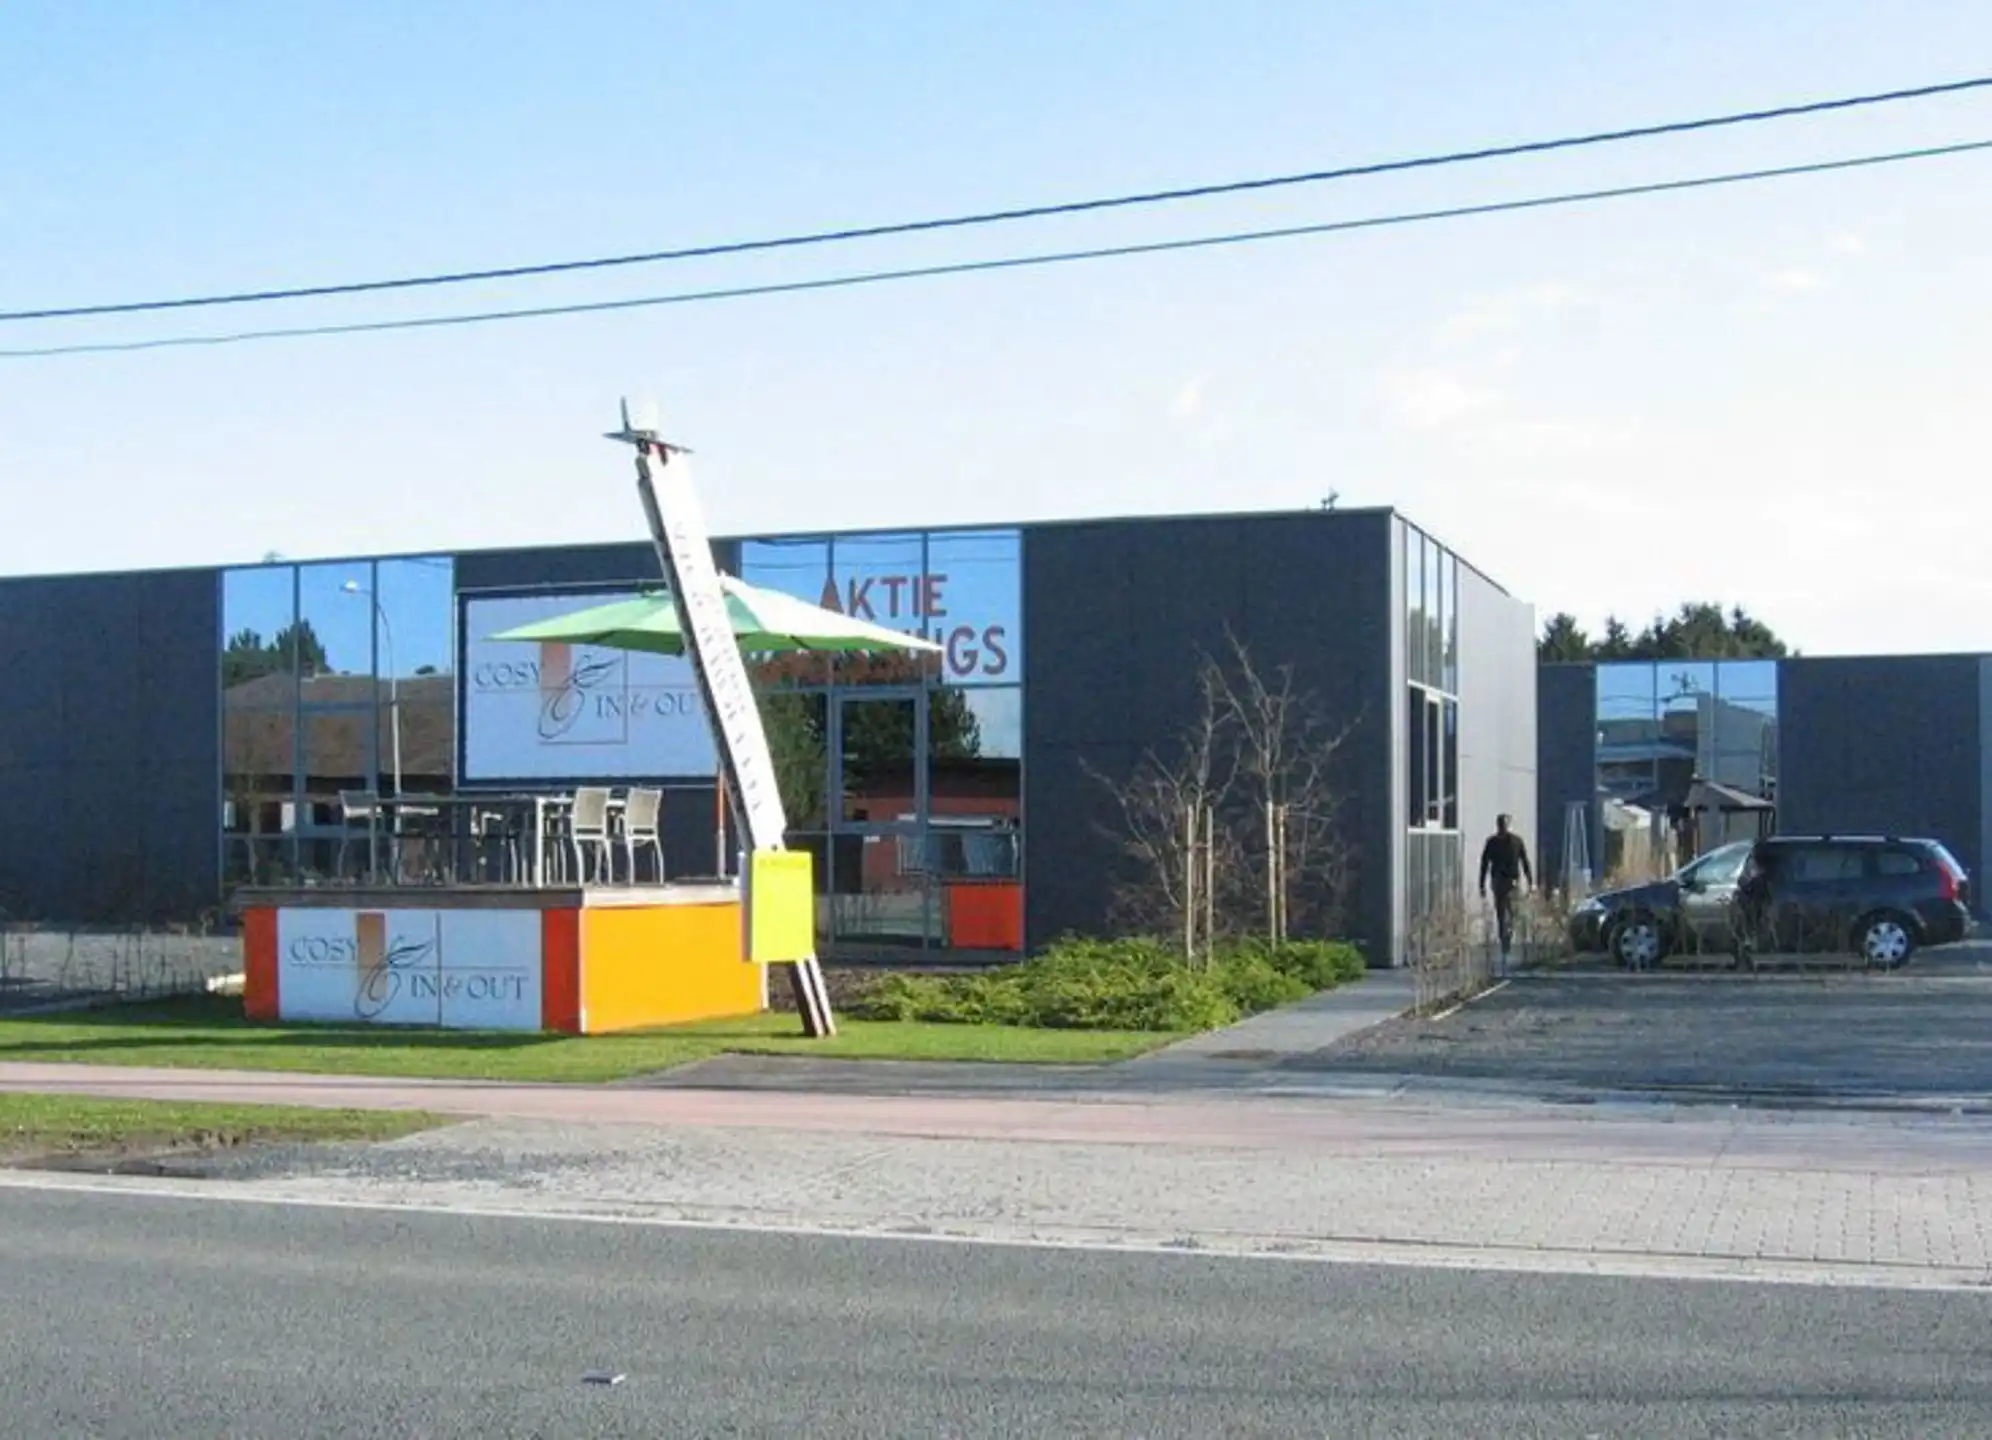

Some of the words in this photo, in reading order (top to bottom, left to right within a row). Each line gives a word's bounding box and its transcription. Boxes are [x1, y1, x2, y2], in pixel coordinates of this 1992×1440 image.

[820, 573, 948, 621] AKTIE
[475, 661, 544, 687] COSY
[596, 693, 622, 719] IN
[655, 692, 701, 716] OU
[289, 936, 361, 962] COSY
[410, 974, 437, 998] IN
[467, 974, 529, 1000] OUT
